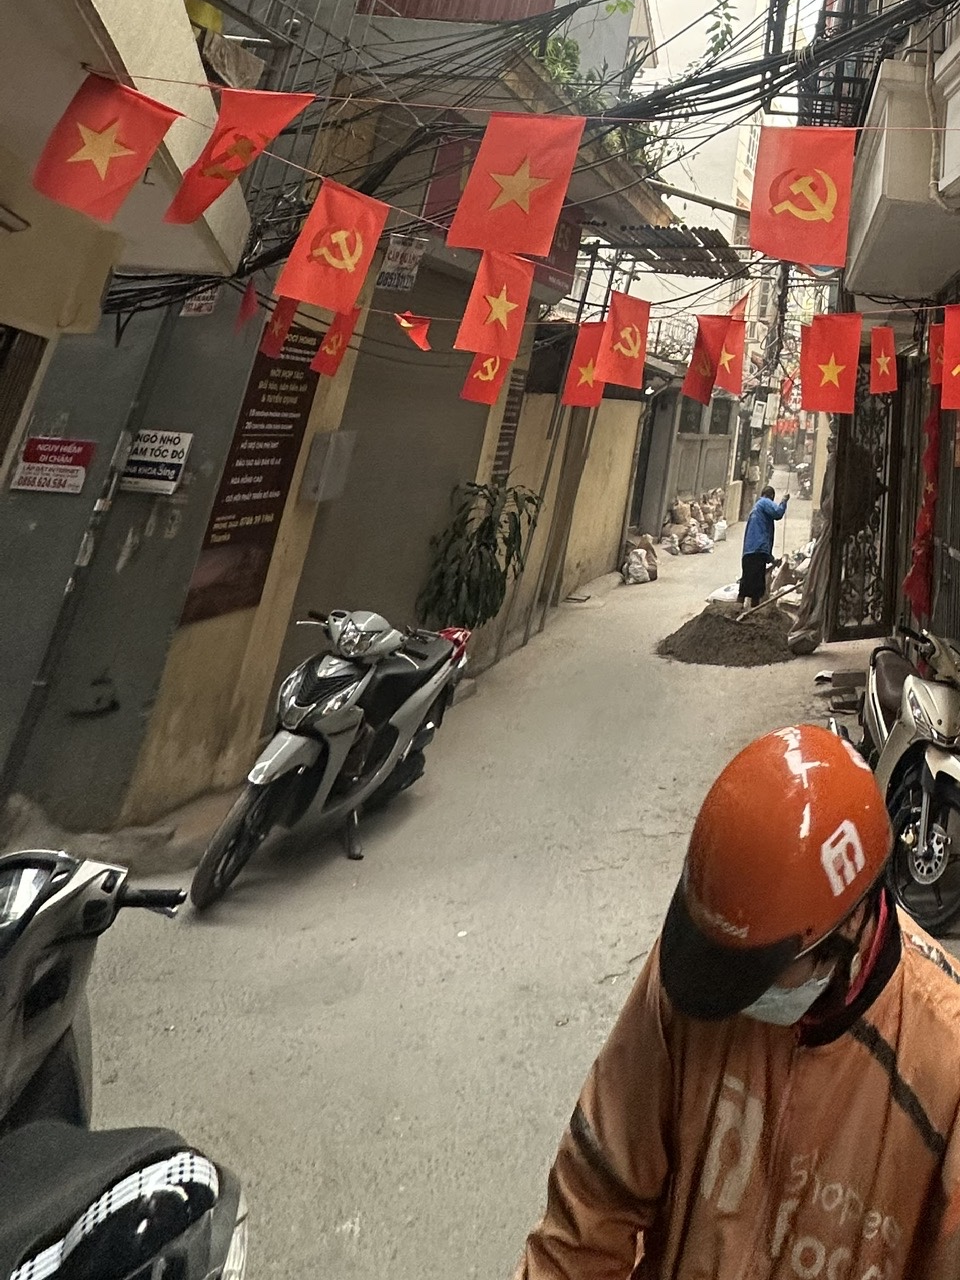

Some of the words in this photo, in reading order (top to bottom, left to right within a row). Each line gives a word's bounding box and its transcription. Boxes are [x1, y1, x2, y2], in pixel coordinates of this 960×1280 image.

[37, 443, 59, 452] NGUY
[149, 445, 169, 458] TỐC
[170, 449, 185, 462] ĐỘ
